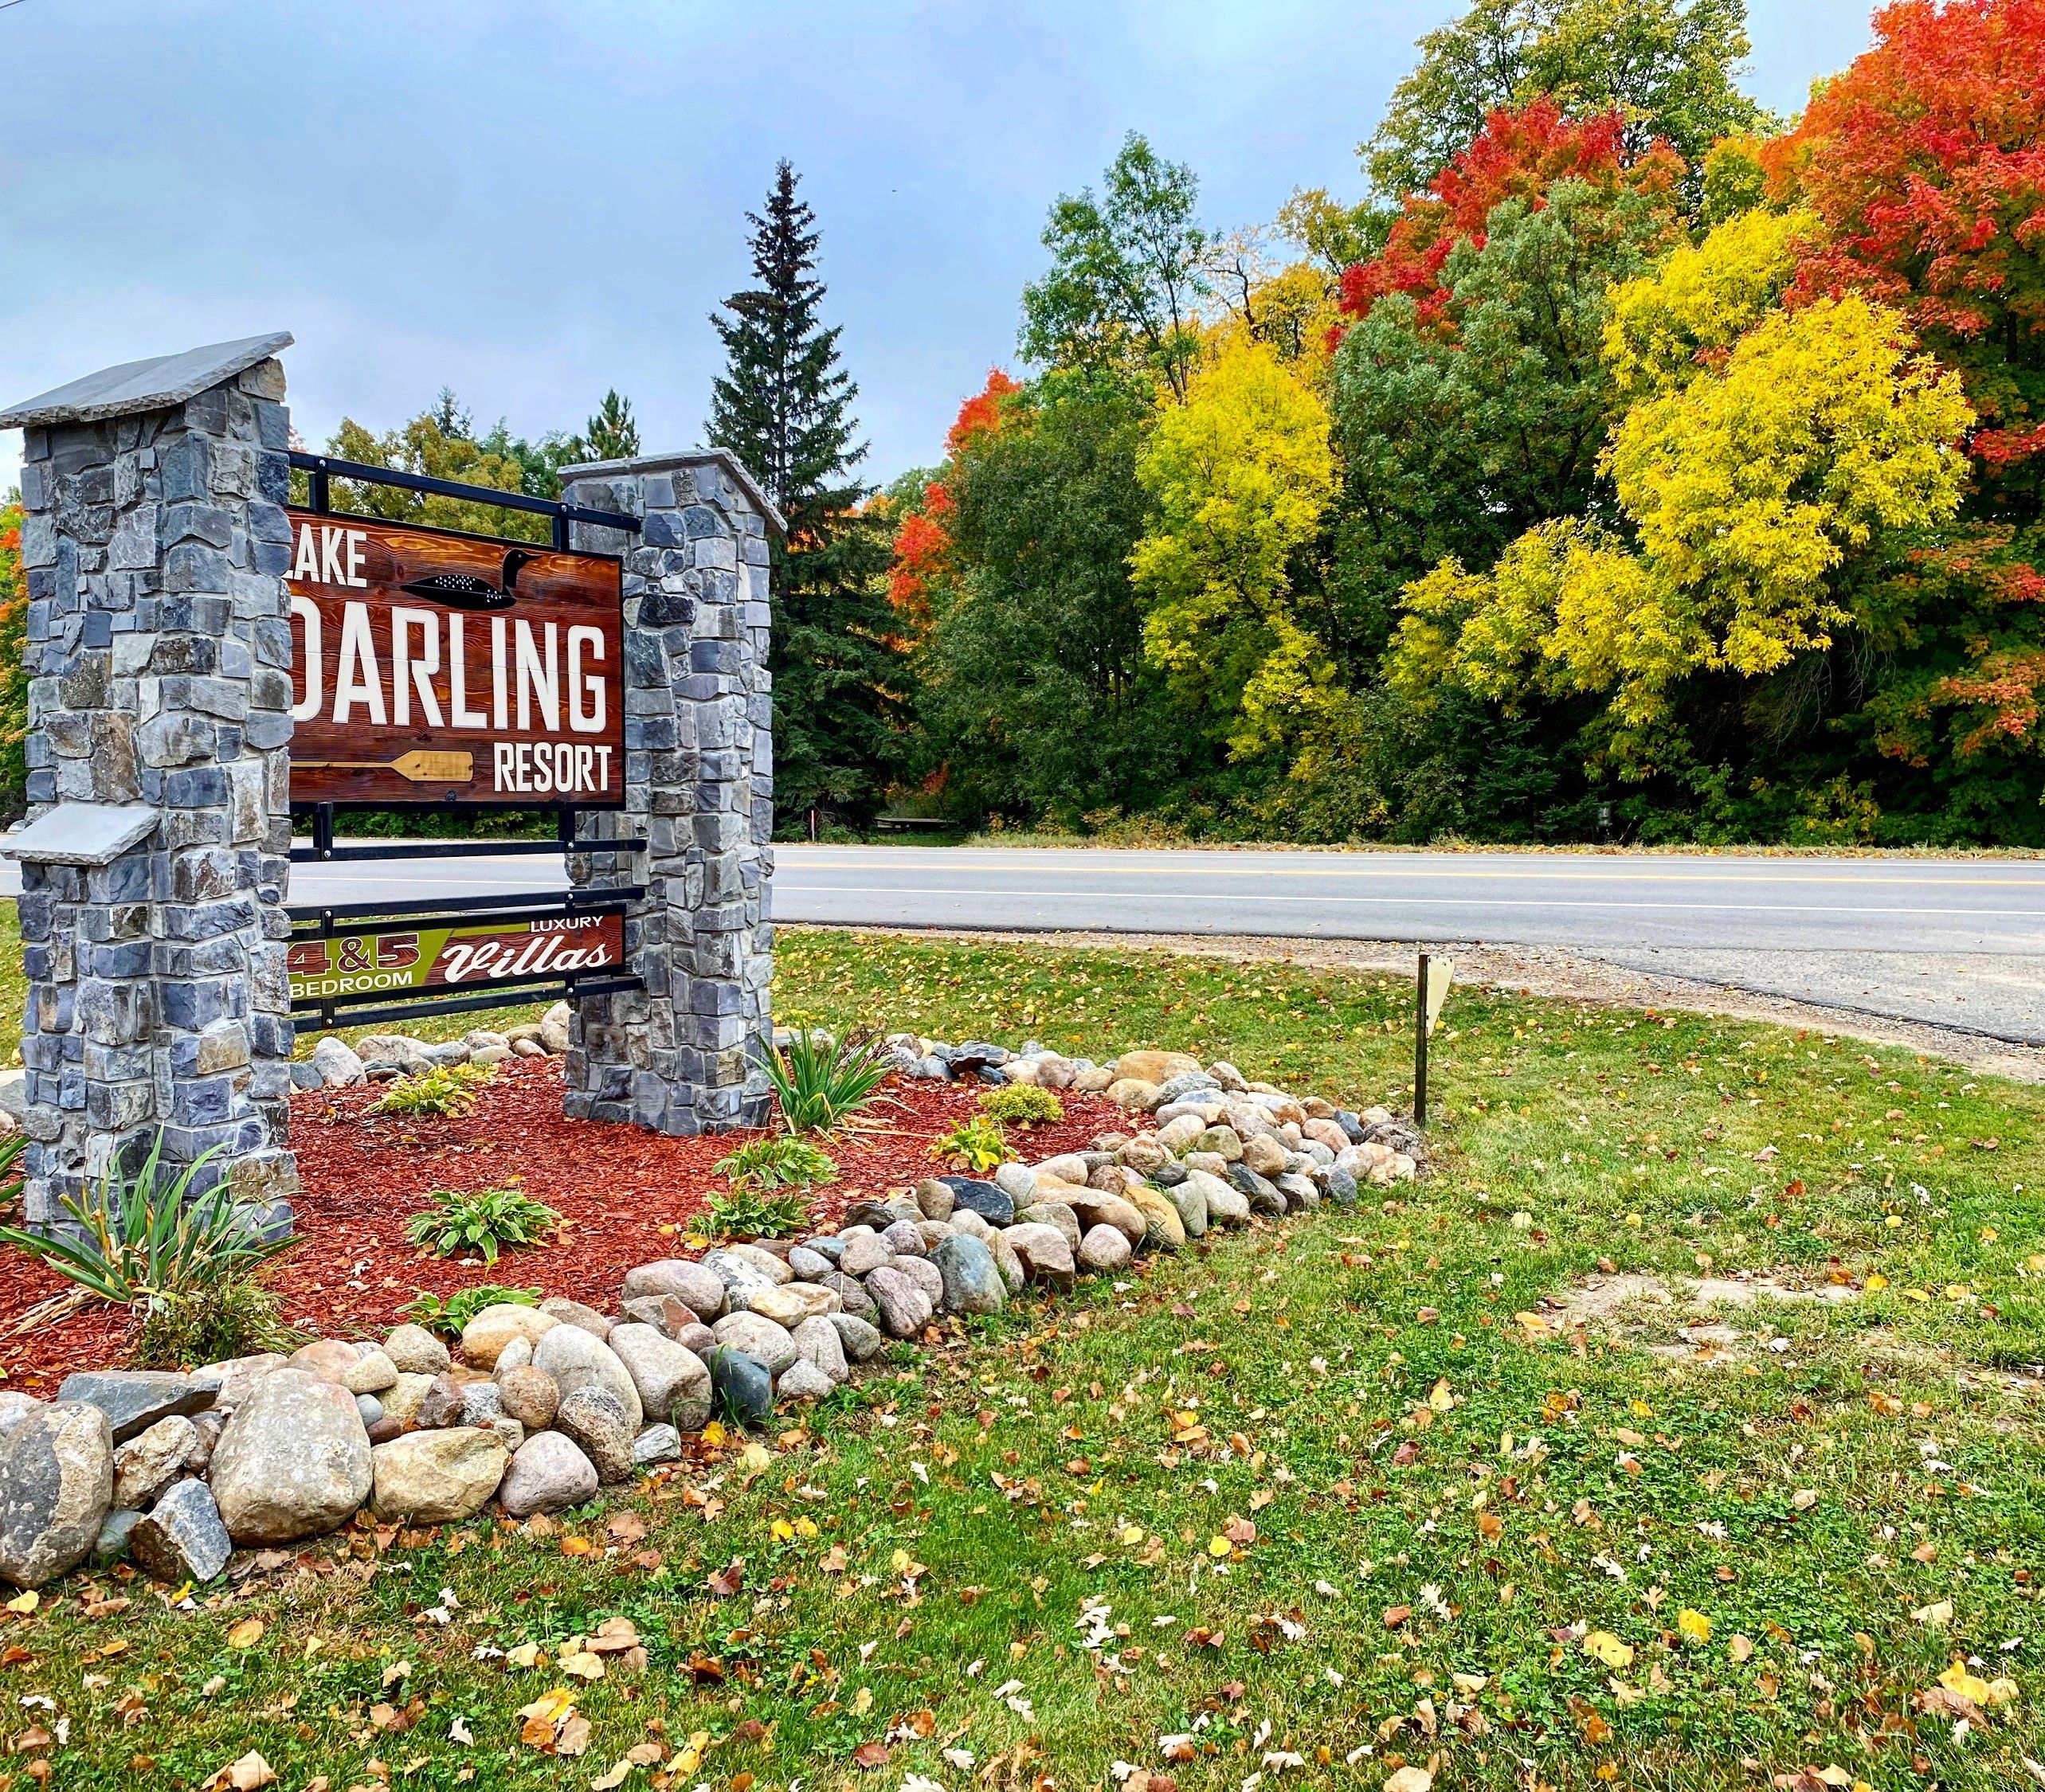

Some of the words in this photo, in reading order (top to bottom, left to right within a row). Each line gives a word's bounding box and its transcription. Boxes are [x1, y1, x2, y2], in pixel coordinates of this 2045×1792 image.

[281, 522, 367, 588] AKE
[493, 741, 613, 792] RESORT
[530, 915, 603, 933] LUXURY
[287, 932, 421, 977] 4&5
[441, 934, 613, 984] Villas
[289, 971, 413, 998] BEDROOM
